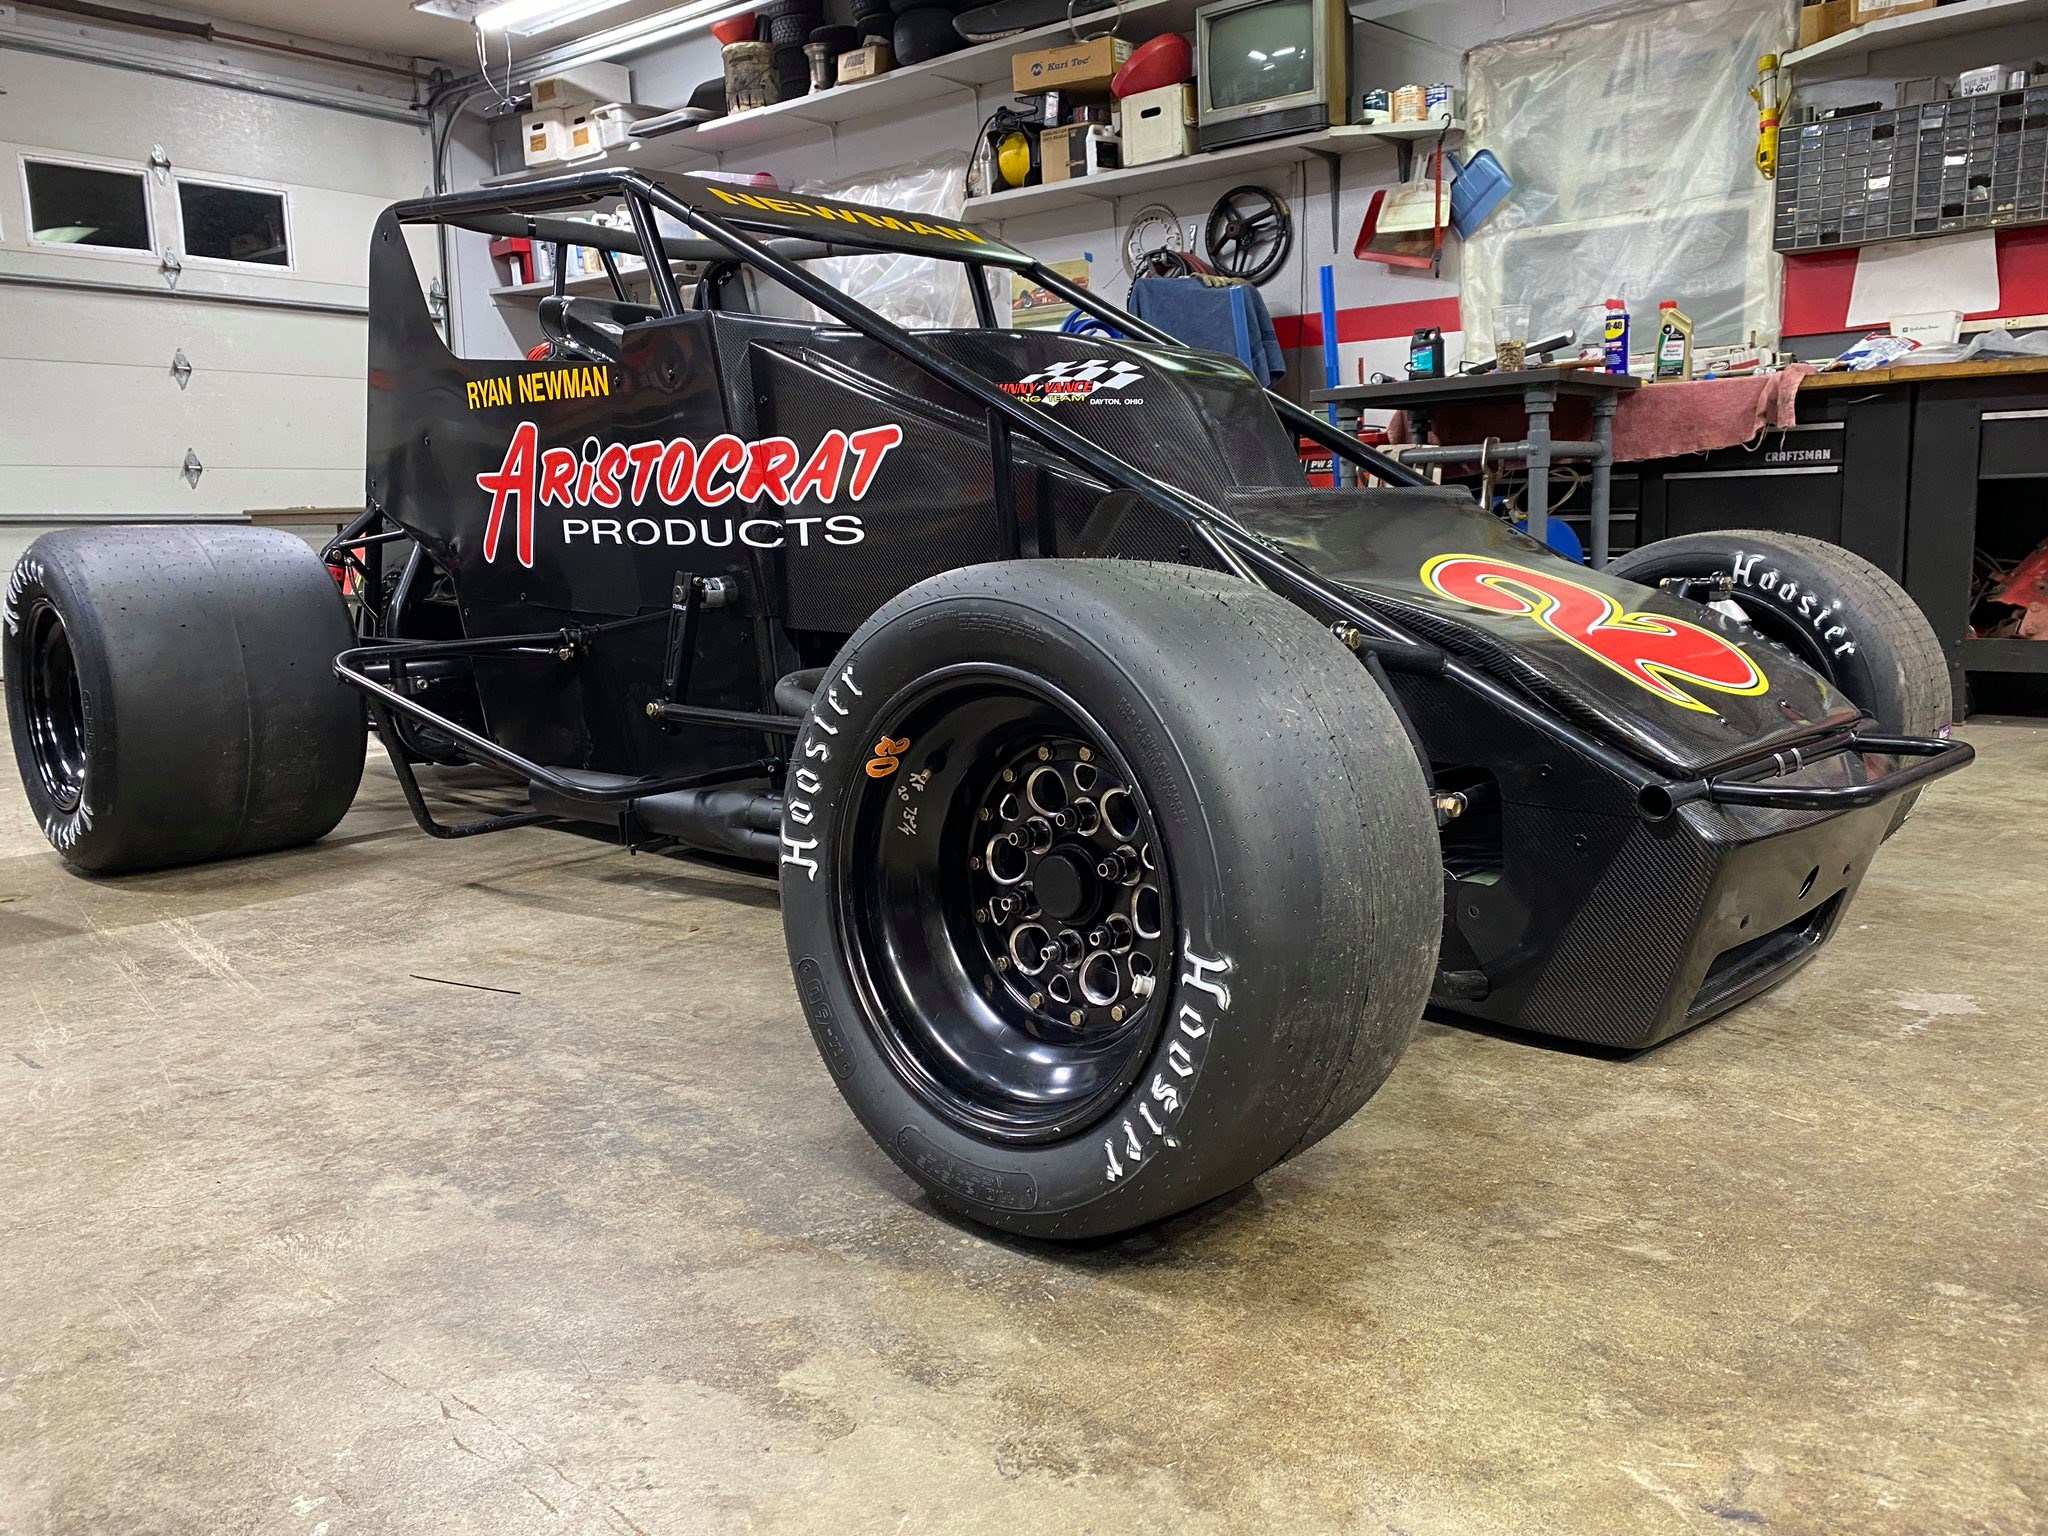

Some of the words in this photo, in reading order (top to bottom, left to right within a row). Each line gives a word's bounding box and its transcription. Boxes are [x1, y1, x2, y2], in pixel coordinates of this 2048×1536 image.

[706, 187, 988, 245] NEWMAN
[466, 377, 513, 410] RYAN
[518, 366, 610, 403] NEWMAN
[1044, 381, 1094, 393] VANCE
[1048, 394, 1085, 403] TEAM
[1090, 398, 1122, 406] DAYTON,
[1311, 460, 1326, 469] PW
[1765, 449, 1831, 463] CRAFTSMAN
[562, 515, 866, 547] PRODUCTS
[1731, 551, 1857, 656] Hoosier
[1419, 552, 1770, 716] 2
[779, 666, 863, 883] Hoosier
[1104, 928, 1233, 1182] Hoosier
